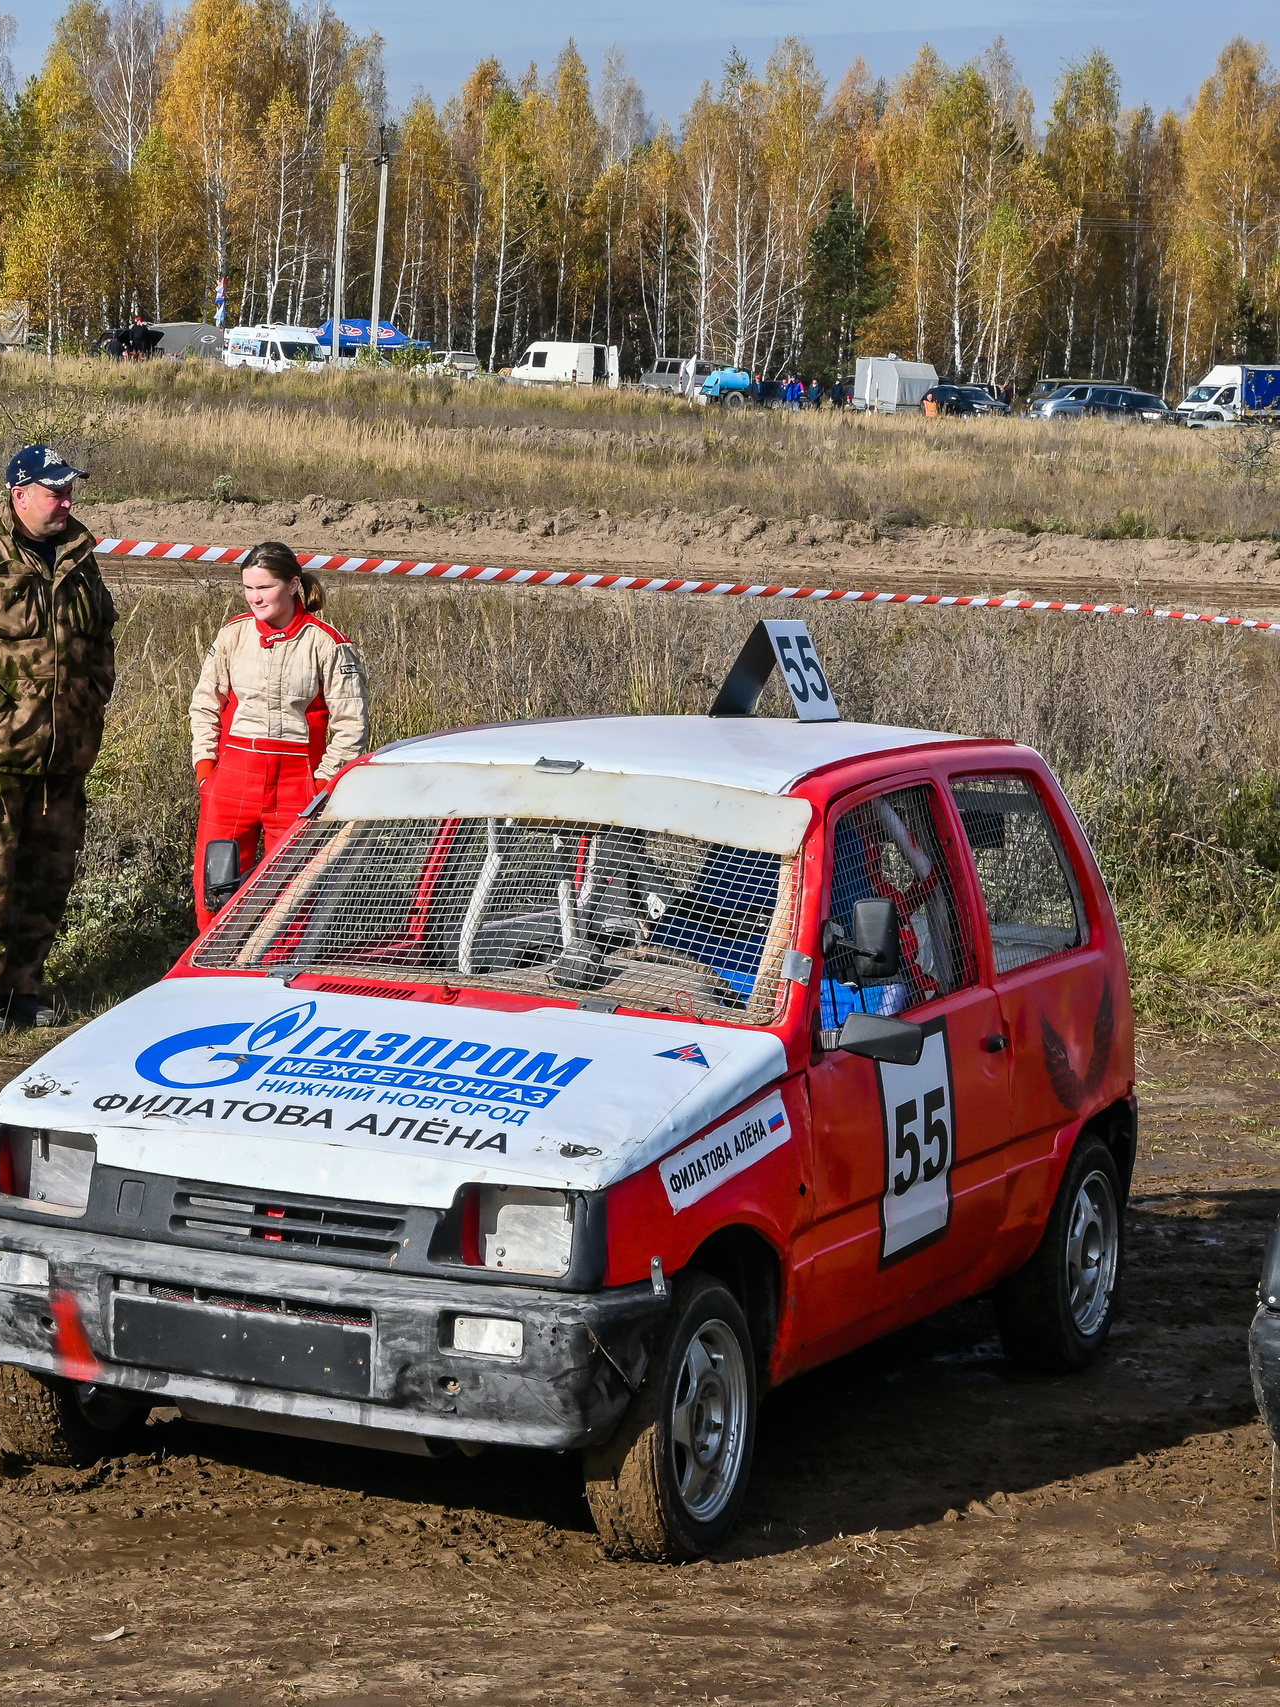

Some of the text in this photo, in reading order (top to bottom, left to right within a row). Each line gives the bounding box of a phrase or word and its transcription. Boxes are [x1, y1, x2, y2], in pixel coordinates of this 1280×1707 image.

[775, 635, 829, 704] 55
[275, 1060, 549, 1104] МЕЖРЕГИОНГАЗ
[287, 1026, 594, 1088] ГАЗПРОМ
[92, 1093, 509, 1155] ФИЛАТОВА АЛЁНА
[255, 1079, 531, 1127] НИЖНИЙ НОВГОРОД
[669, 1117, 768, 1196] ФИЛАТОВА АЛЁНА
[893, 1085, 949, 1198] 55
